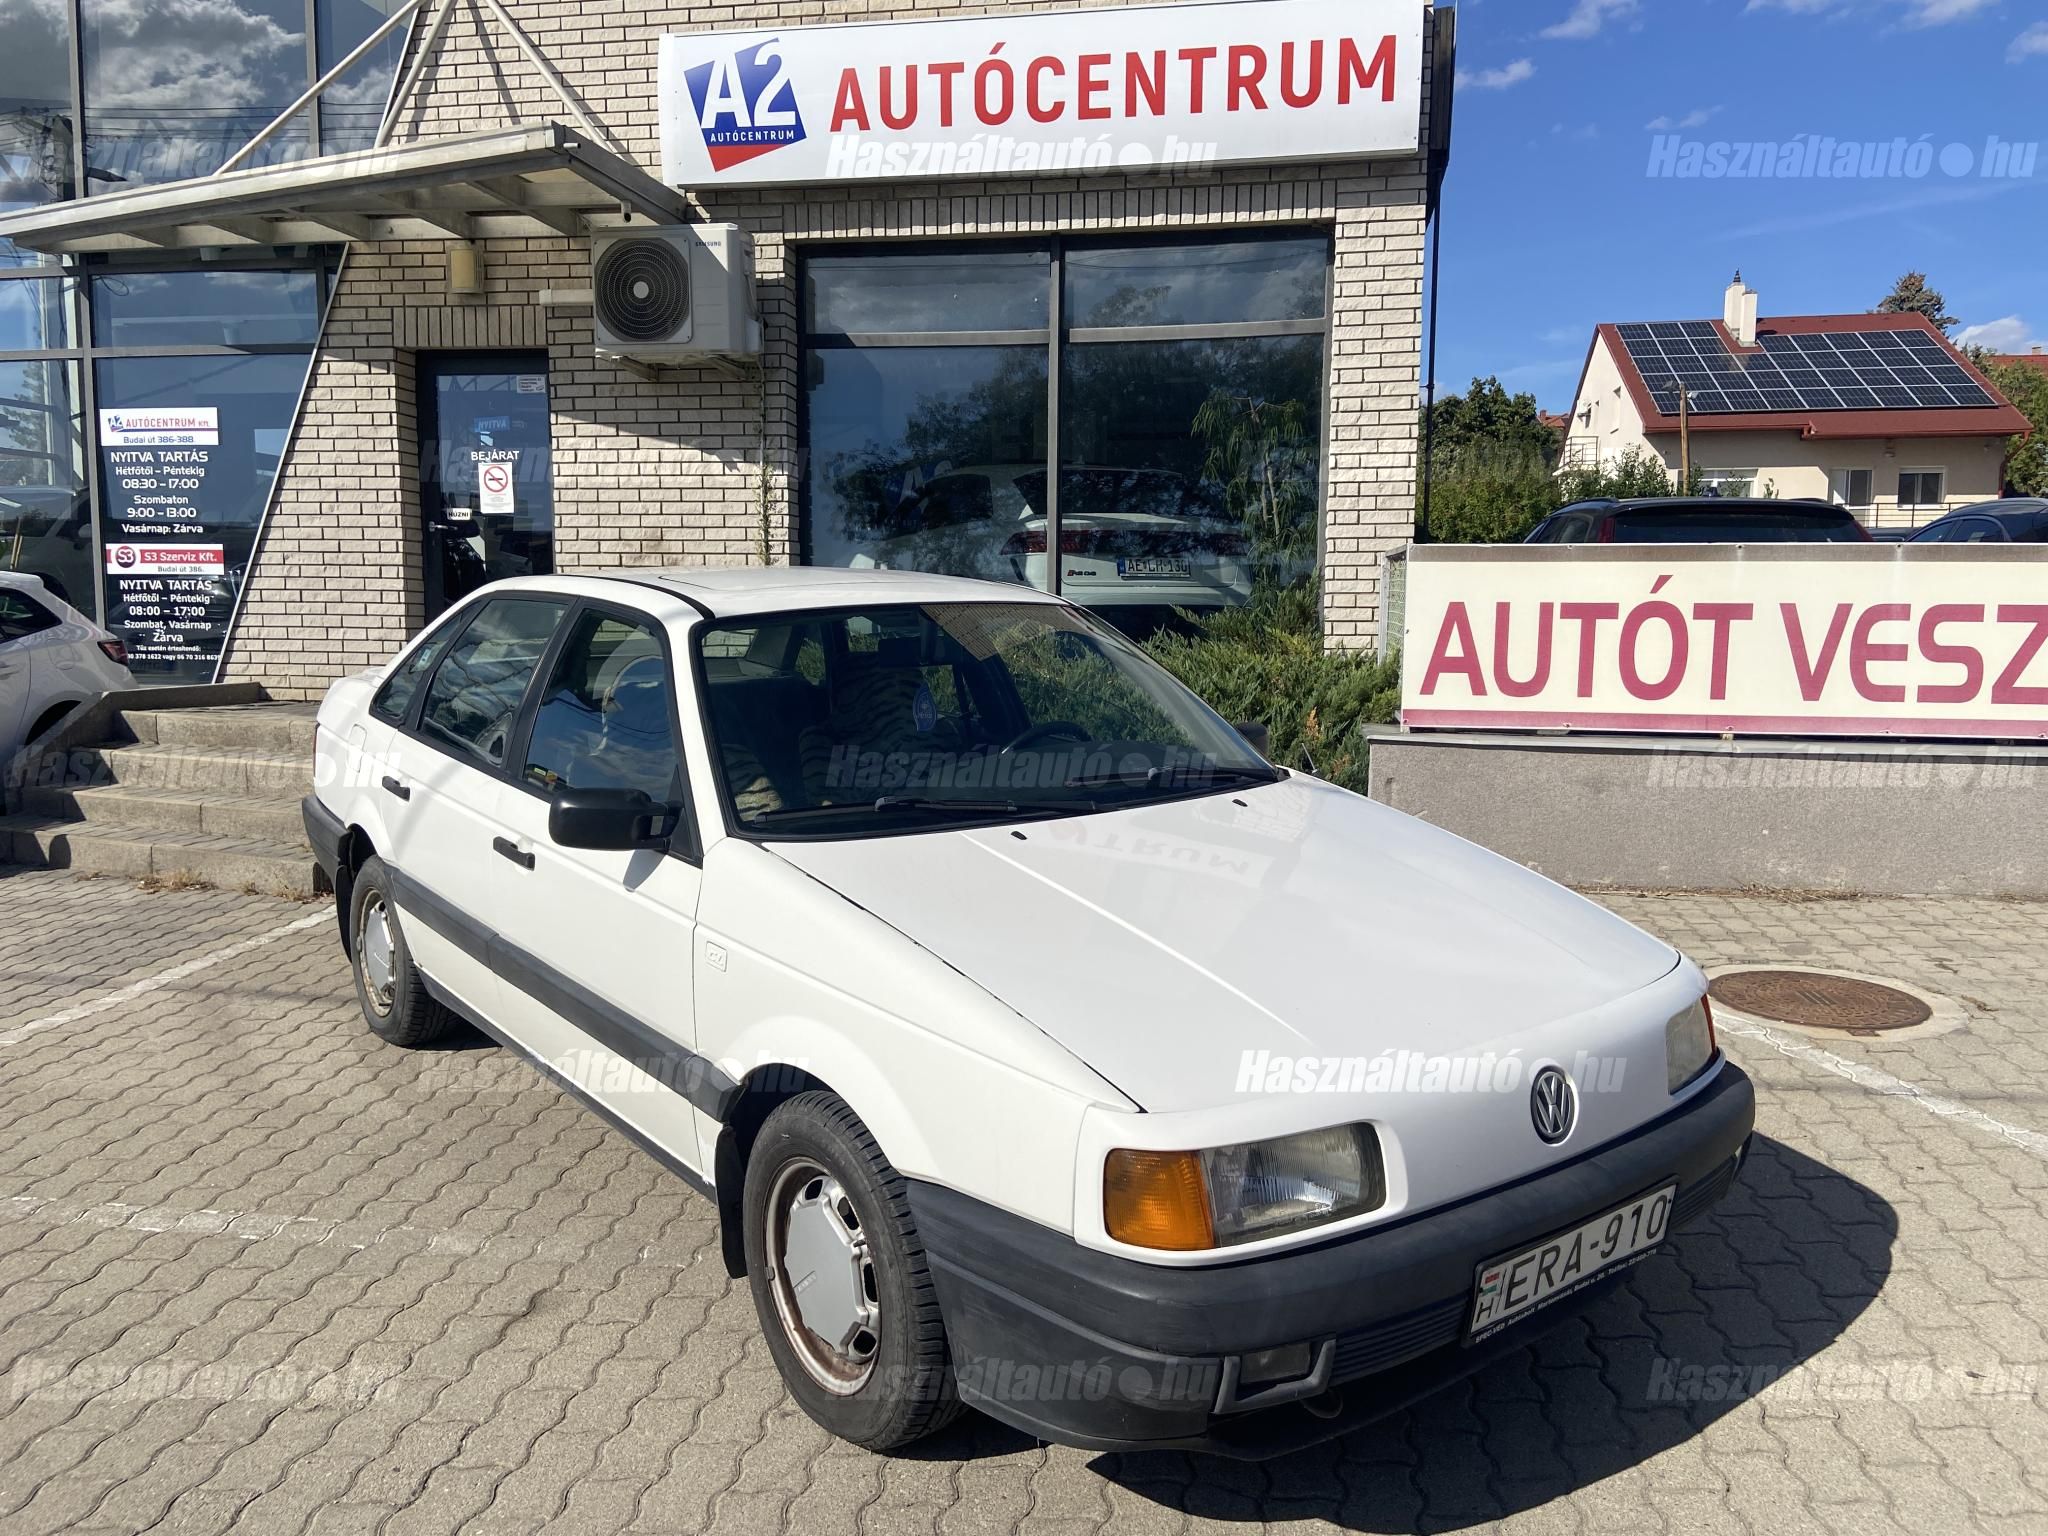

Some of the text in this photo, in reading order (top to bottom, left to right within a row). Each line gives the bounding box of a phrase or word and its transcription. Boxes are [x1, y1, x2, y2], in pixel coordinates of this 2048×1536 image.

[701, 41, 796, 128] A2
[829, 35, 1397, 133] AUTÓCENTRUM
[710, 130, 794, 142] AUTÓCENTRUM
[126, 417, 196, 428] AUTÓCENTRUM
[123, 436, 146, 444] Budai
[147, 436, 155, 444] út
[110, 448, 208, 463] NYITVA TARTÁS
[470, 449, 520, 461] BEJÁRAT
[115, 466, 153, 475] Hétfőtől
[163, 466, 205, 477] Péntekig
[122, 478, 157, 489] 08:30
[168, 478, 199, 489] 17:00
[133, 494, 189, 505] Szombaton
[127, 507, 155, 518] 9:00
[166, 507, 197, 518] 13:00
[122, 523, 204, 535] Vasárnap: Zárva
[117, 549, 217, 563] S3 S3 Szerviz Kft.
[157, 565, 178, 573] Budai
[179, 565, 188, 573] út
[119, 577, 212, 590] NYITVA TARTÁS
[123, 593, 159, 603] Hétfőtől
[170, 594, 210, 604] Péntekig
[129, 606, 160, 616] 08:00
[173, 606, 205, 616] 17:00
[124, 620, 212, 631] Szombat, Vasárnap
[153, 630, 184, 642] Zárva
[1418, 574, 2048, 705] AUTÓT VESZ
[1502, 1194, 1668, 1312] ERA-910
